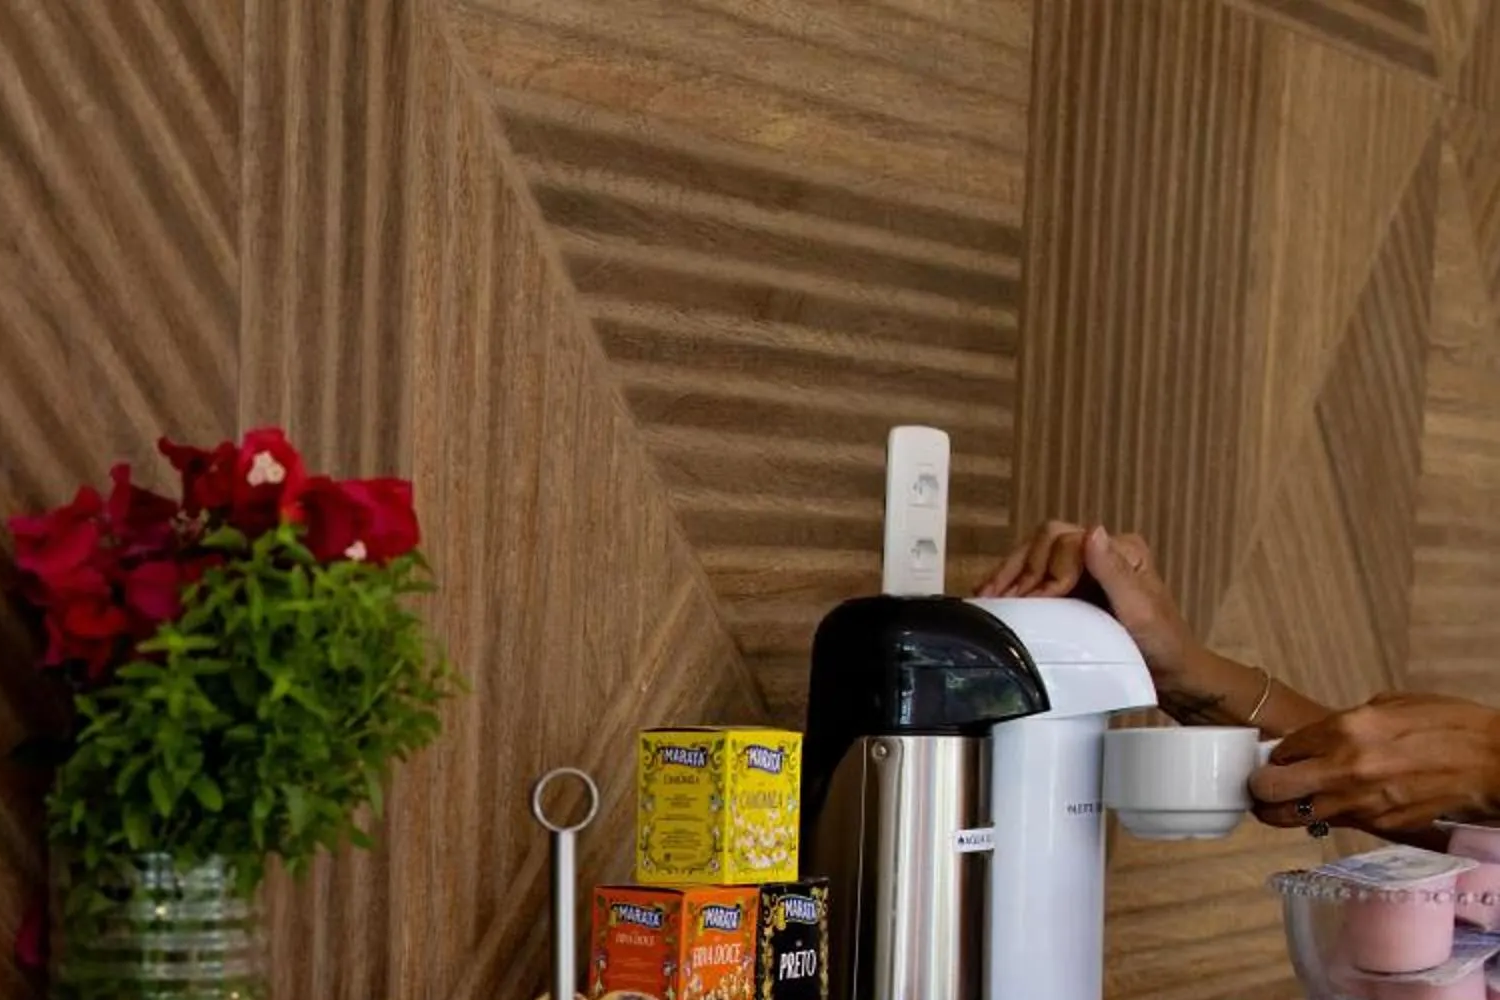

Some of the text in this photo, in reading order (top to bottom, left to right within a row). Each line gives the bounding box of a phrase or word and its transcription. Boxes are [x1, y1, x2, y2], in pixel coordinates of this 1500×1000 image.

[692, 943, 741, 967] ERVA DOCE
[779, 949, 817, 981] PRETO
